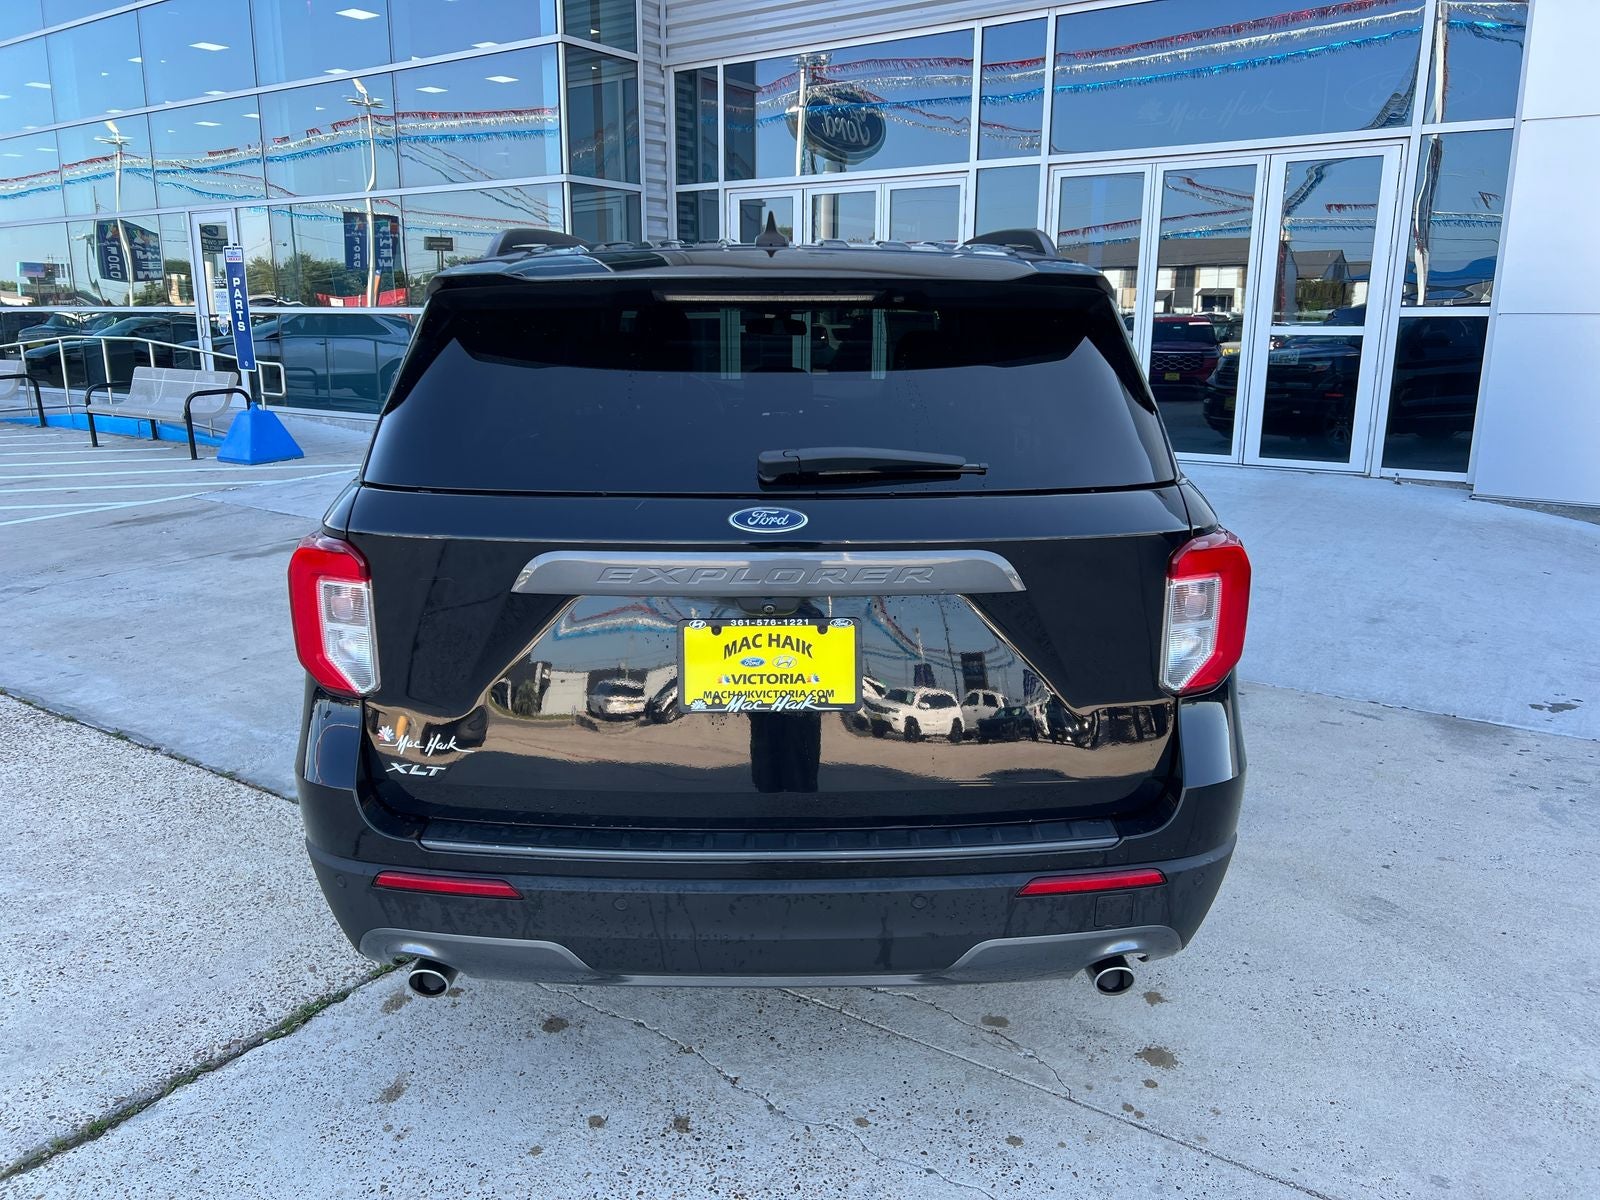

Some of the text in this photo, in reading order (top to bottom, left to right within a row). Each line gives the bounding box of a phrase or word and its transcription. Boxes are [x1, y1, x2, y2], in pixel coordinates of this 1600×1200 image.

[232, 277, 246, 332] PARTS
[746, 510, 790, 526] Ford
[596, 566, 935, 585] EXPLORER
[730, 619, 809, 627] 361-576-1221
[723, 633, 813, 660] MAC HAIK
[742, 657, 762, 667] Ford
[731, 673, 806, 685] VICTORIA
[703, 689, 835, 699] MACHAIKVICTORIACOM
[714, 694, 834, 712] Mac Haik
[389, 733, 470, 757] Mac Haik
[385, 762, 447, 777] XLT
